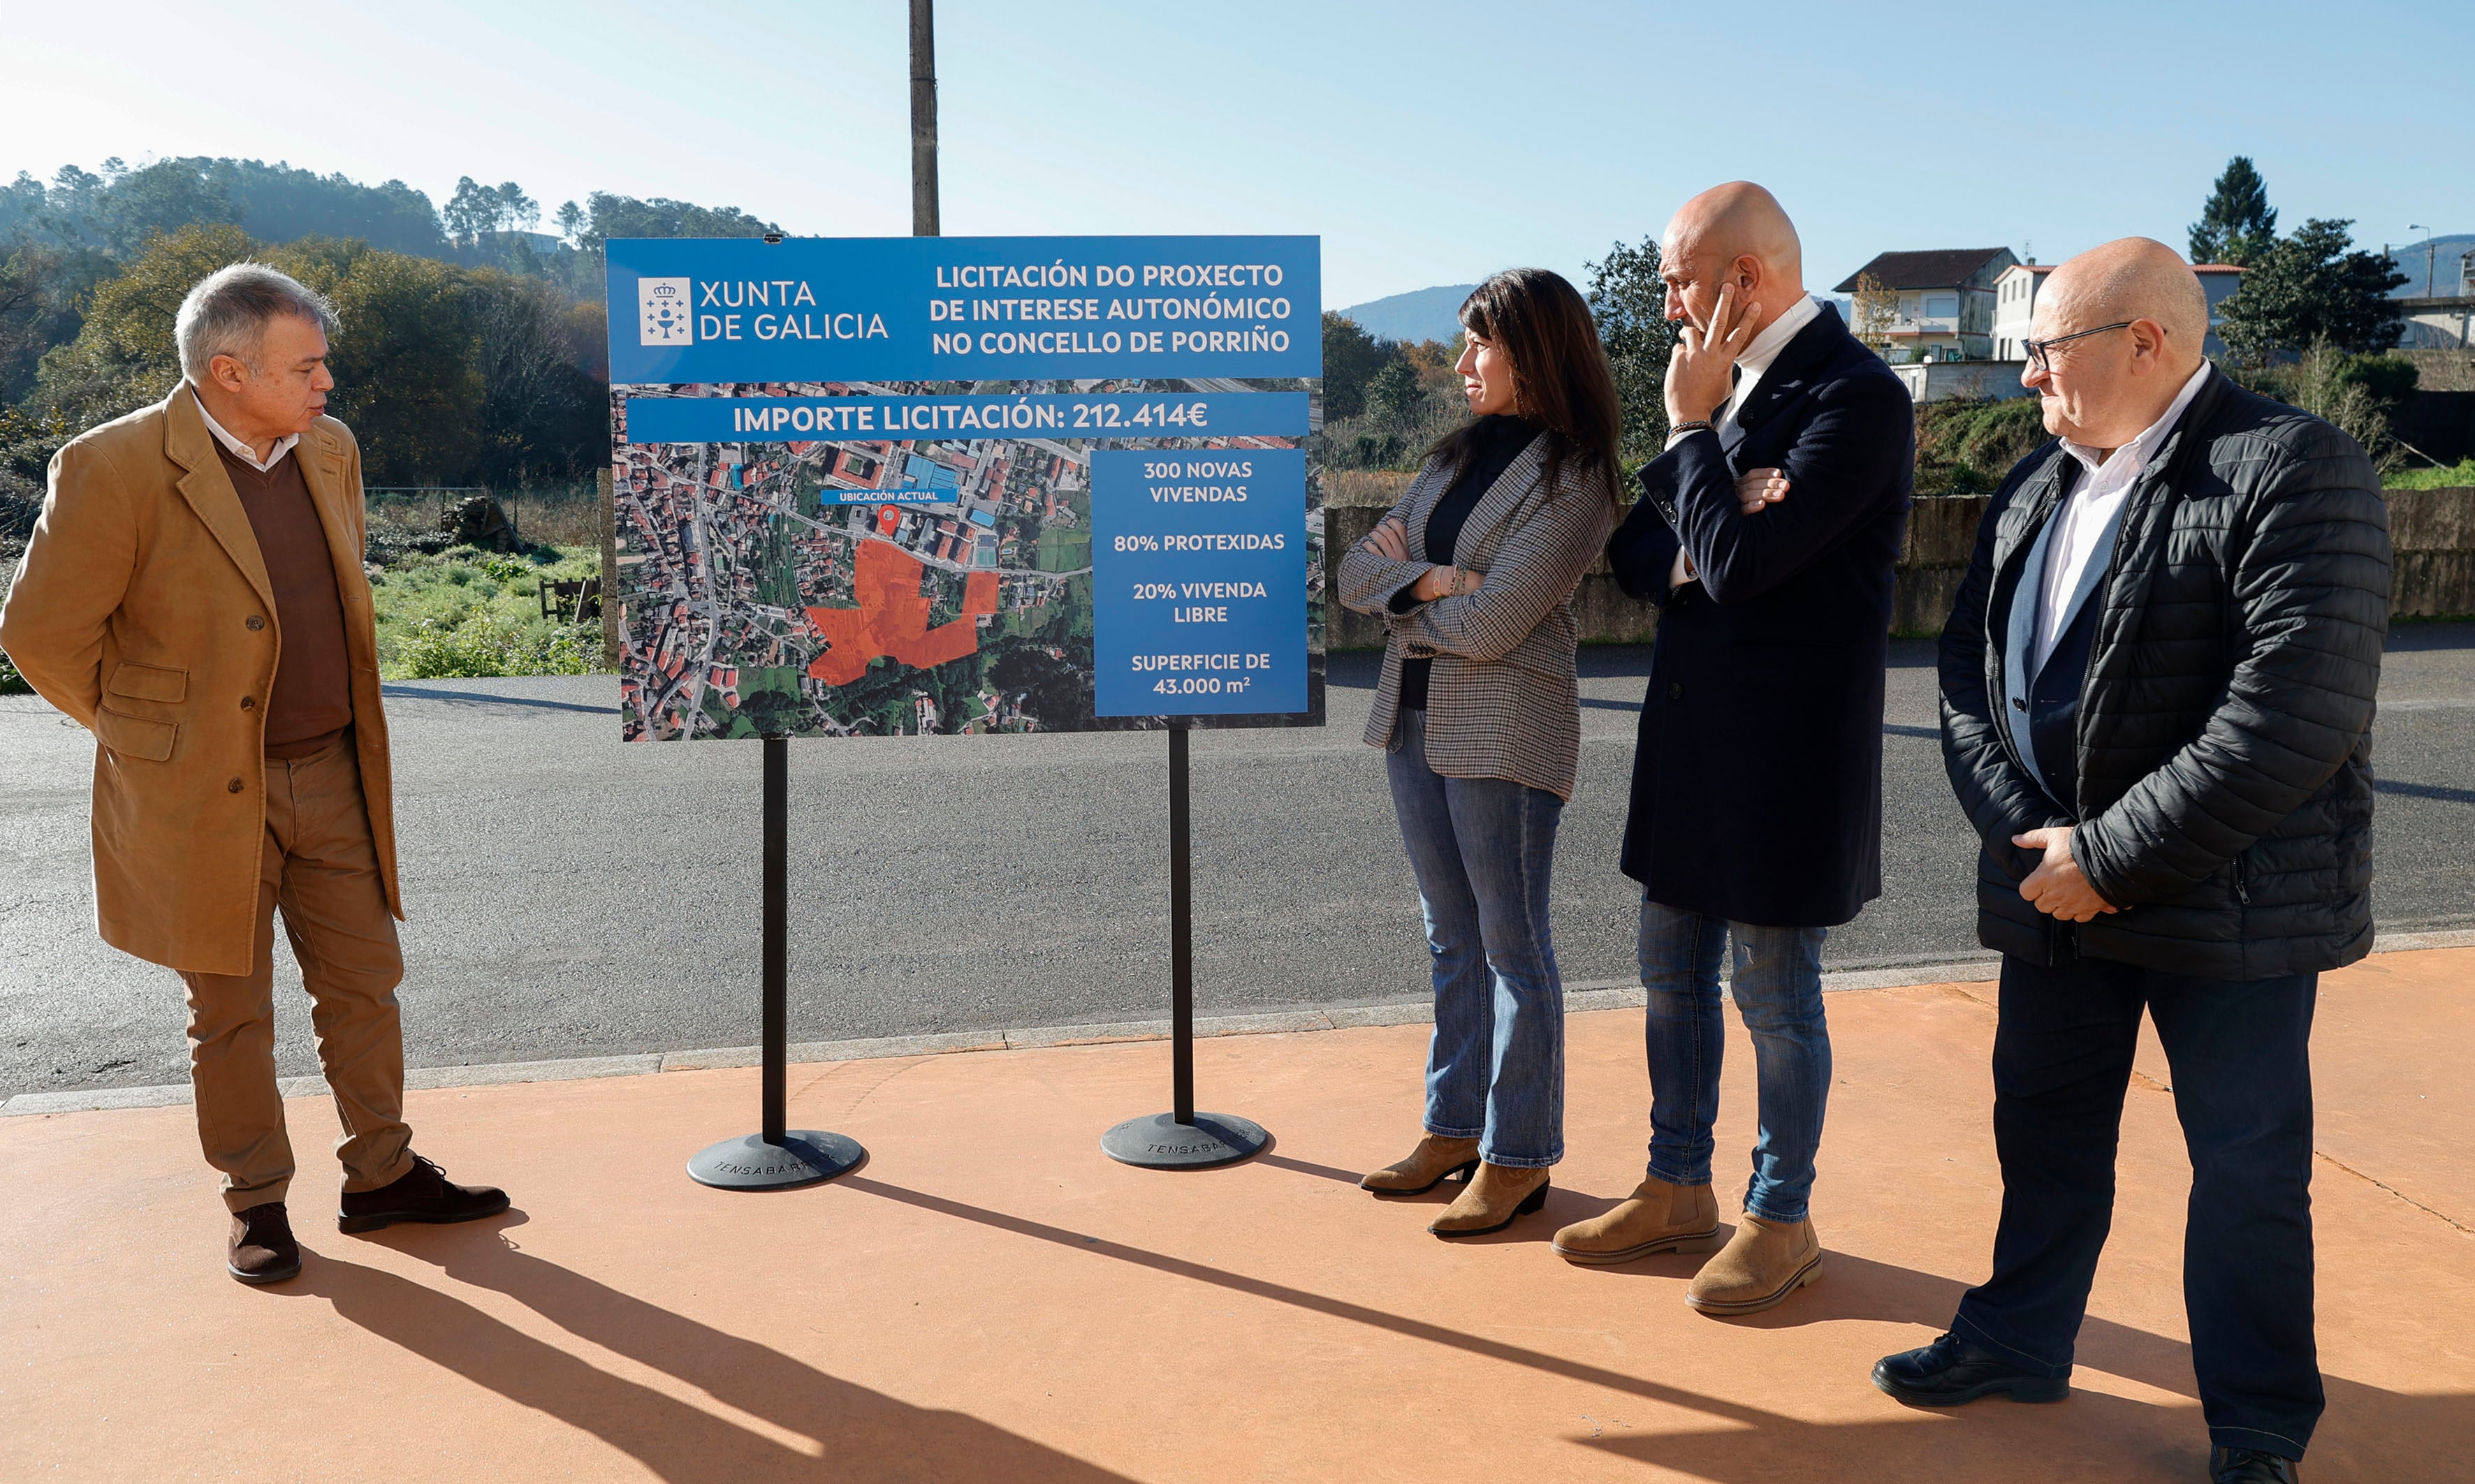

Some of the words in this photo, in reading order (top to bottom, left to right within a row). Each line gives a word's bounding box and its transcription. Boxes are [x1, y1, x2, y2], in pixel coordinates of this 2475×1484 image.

[937, 258, 1087, 288] LICITACIÓN
[1096, 265, 1135, 287] DO
[1143, 264, 1283, 287] PROXECTO
[700, 281, 817, 307] XUNTA
[930, 300, 965, 321] DE
[972, 298, 1100, 321] INTERESE
[1106, 291, 1291, 320] AUTONÓMICO
[700, 314, 743, 340] DE
[754, 313, 889, 340] GALICIA
[933, 332, 972, 355] NO
[979, 331, 1122, 355] CONCELLO
[1130, 331, 1164, 353] DE
[1171, 324, 1290, 353] PORRIÑO
[734, 406, 875, 432] IMPORTE
[884, 397, 1065, 430] LICITACIÓN:
[1073, 402, 1208, 428] 212.414€
[1144, 462, 1181, 479] 300
[1187, 462, 1253, 478] NOVAS
[840, 490, 894, 501] UBICACIÓN
[897, 491, 939, 501] ACTUAL
[1149, 485, 1248, 503] VIVENDAS
[1114, 535, 1159, 552] 80%
[1164, 534, 1285, 551] PROTEXIDAS
[1133, 583, 1177, 600] 20%
[1181, 582, 1267, 598] VIVENDA
[1174, 606, 1228, 623] LIBRE
[1132, 654, 1241, 671] SUPERFICIE
[1246, 653, 1271, 669] DE
[1153, 677, 1221, 695] 43.000
